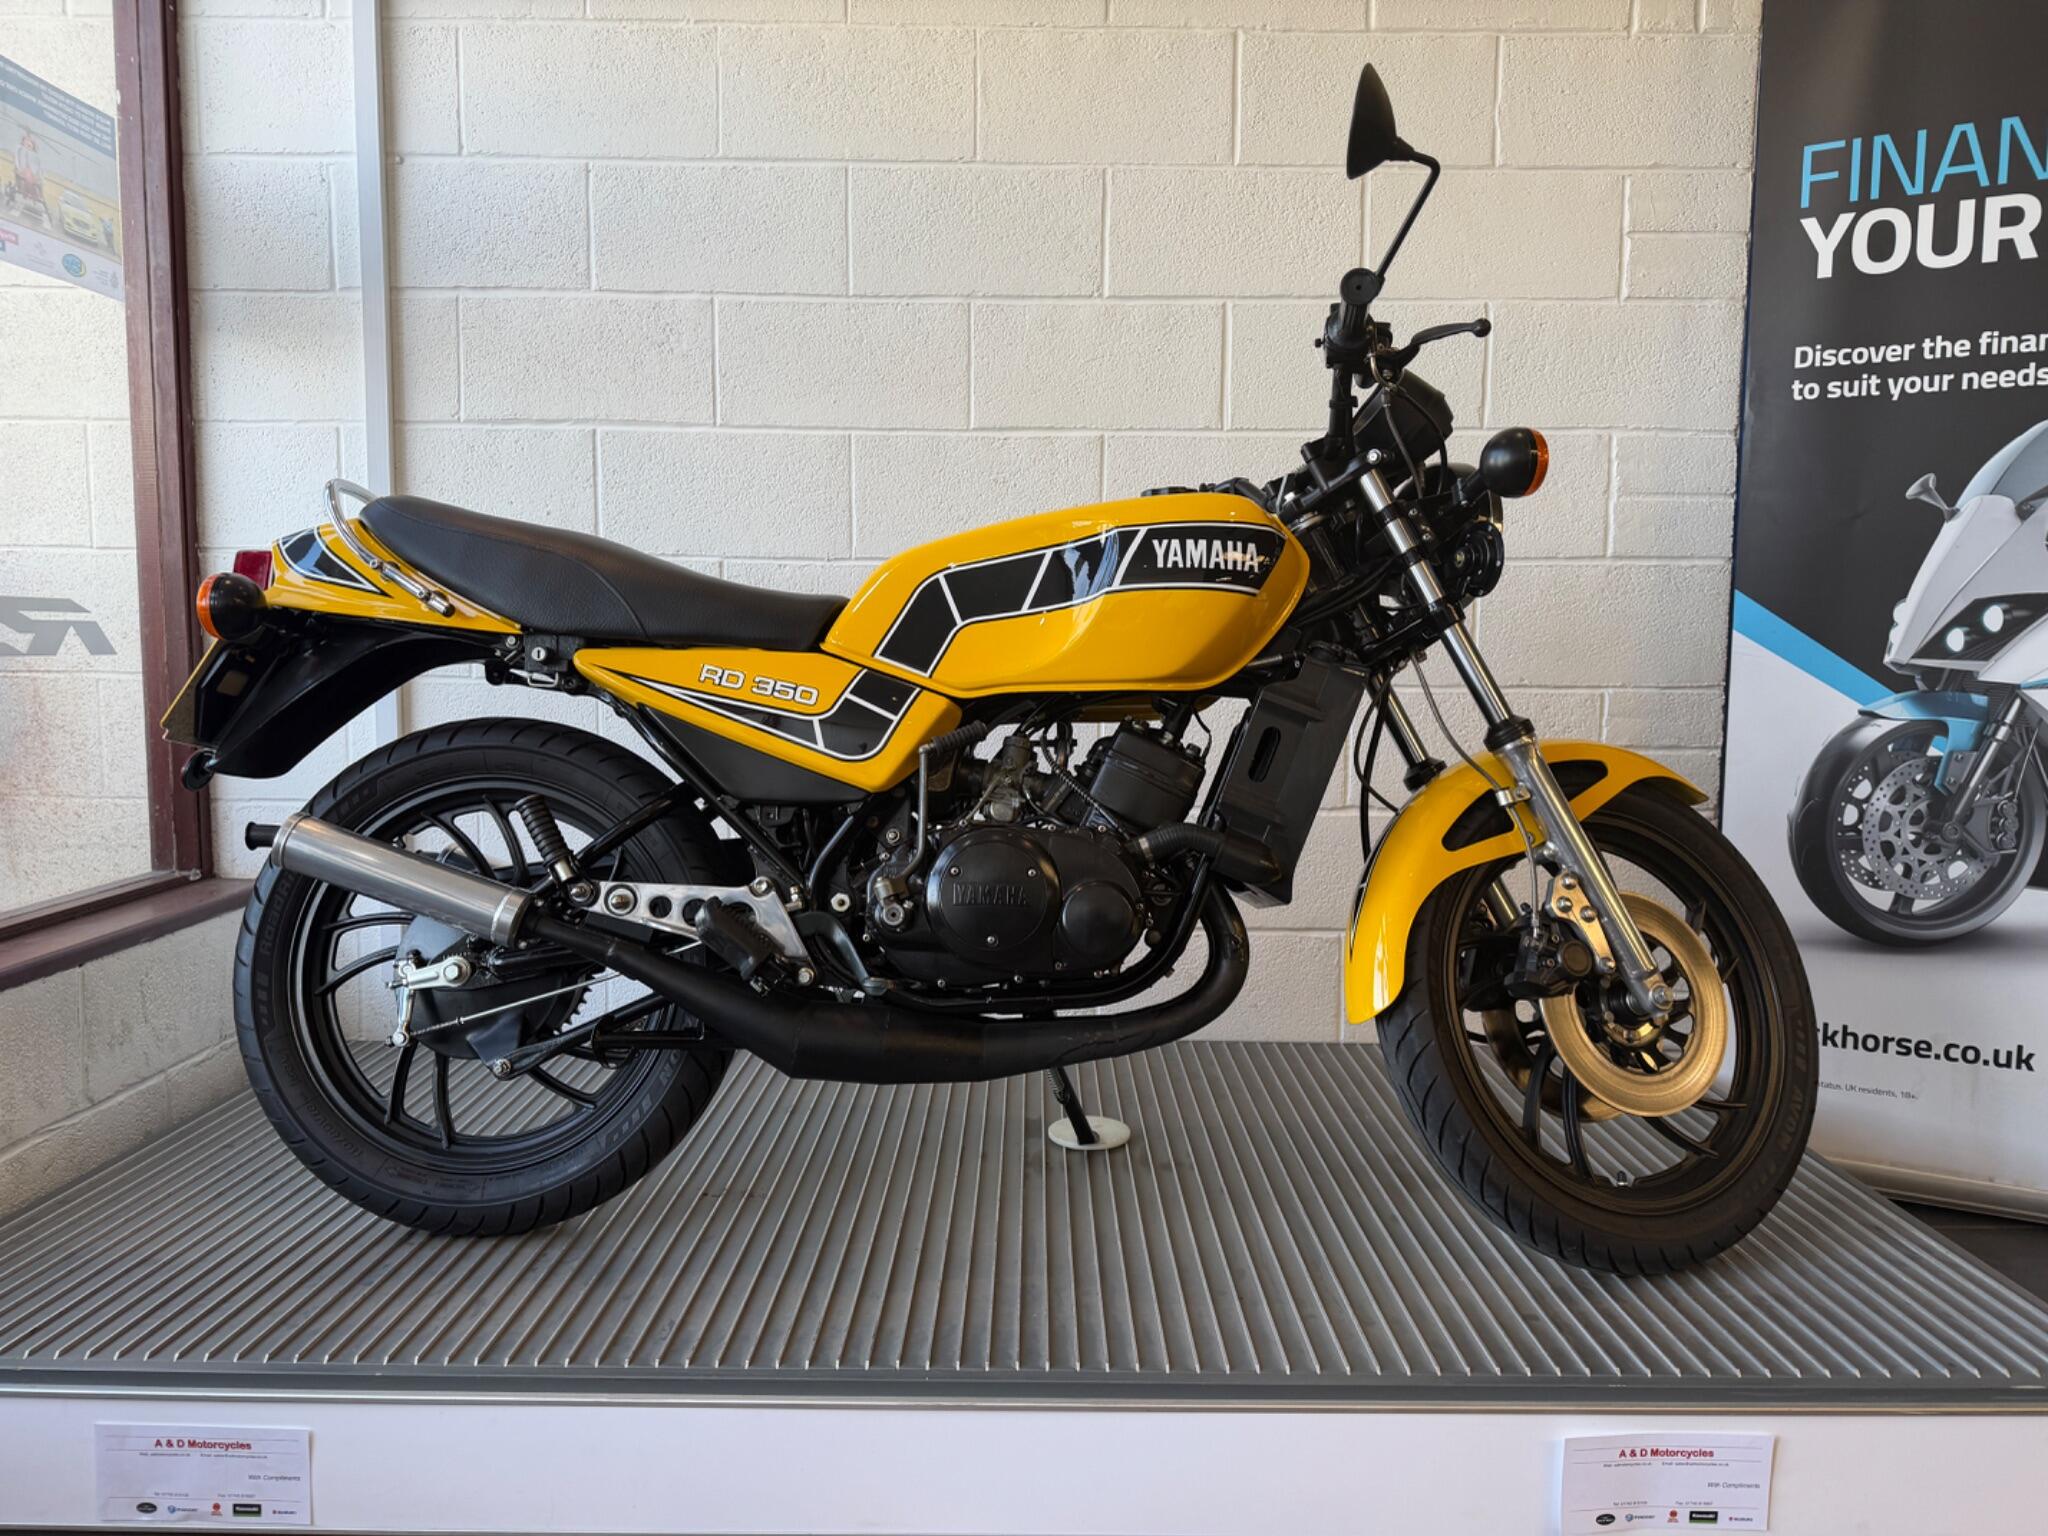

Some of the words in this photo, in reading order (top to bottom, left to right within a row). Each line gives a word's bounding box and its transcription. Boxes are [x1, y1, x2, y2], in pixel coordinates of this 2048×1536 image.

[1800, 193, 2042, 279] YOUR
[1793, 342, 1915, 369] Discover
[1922, 335, 1971, 360] the
[1791, 379, 1820, 401] to
[1827, 373, 1881, 399] suit
[1887, 373, 1954, 402] your
[1961, 362, 2048, 391] needs
[1152, 538, 1259, 573] YAMAHA
[698, 663, 745, 690] RD
[751, 676, 819, 706] 350
[1816, 1021, 2036, 1072] khorse.co.uk
[1845, 1083, 1857, 1093] UK
[154, 1439, 163, 1448] A
[166, 1439, 174, 1448] &
[177, 1439, 185, 1448] D
[188, 1439, 252, 1451] Motorcycles
[1619, 1449, 1627, 1458] A
[1629, 1449, 1637, 1457] &
[1640, 1448, 1648, 1457] D
[1650, 1448, 1714, 1459] Motorcycles
